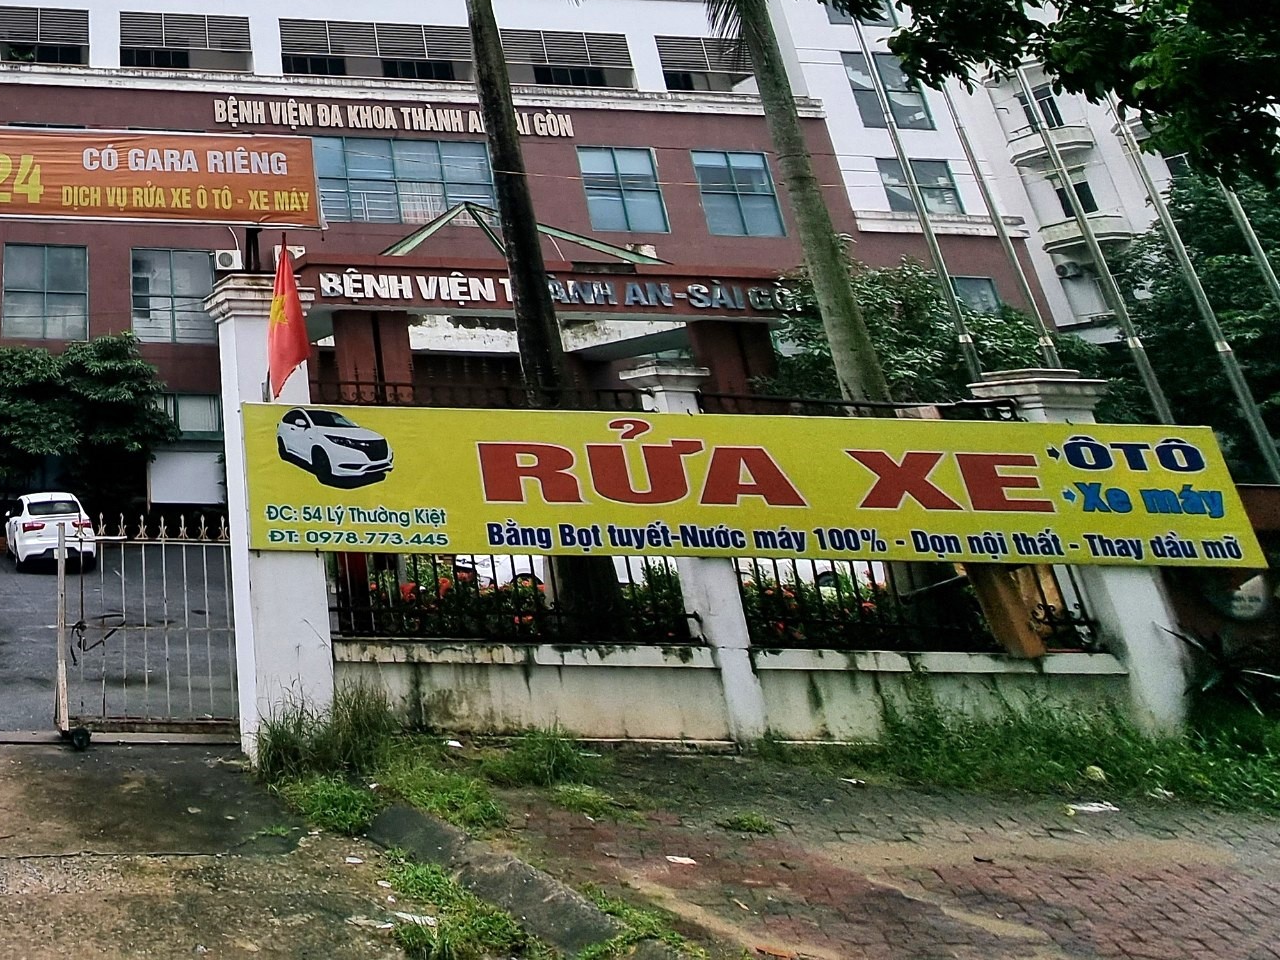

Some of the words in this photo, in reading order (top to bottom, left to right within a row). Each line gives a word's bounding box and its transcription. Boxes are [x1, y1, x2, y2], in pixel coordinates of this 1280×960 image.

[214, 96, 266, 128] BỆNH
[269, 99, 313, 130] VIỆN
[317, 104, 344, 128] ĐA
[347, 105, 397, 130] KHOA
[400, 104, 464, 132] THÀNH
[533, 109, 575, 137] GÒN
[82, 144, 120, 171] CÓ
[127, 148, 199, 173] GARA
[206, 147, 288, 176] RIÊNG
[61, 185, 102, 211] DỊCH
[105, 187, 128, 212] VỤ
[131, 181, 167, 209] RỬA
[170, 188, 192, 209] XE
[196, 185, 209, 210] Ô
[211, 185, 233, 210] TÔ
[247, 190, 270, 211] XE
[273, 188, 310, 212] MÁY
[319, 267, 413, 303] BỆNH
[416, 271, 497, 306] VIỆN
[498, 274, 619, 306] TÀNH
[623, 279, 746, 310] AN-SÀI
[746, 282, 800, 312] GÒ
[478, 419, 808, 506] RỬA
[845, 450, 1056, 513] XE
[1064, 436, 1206, 472] ÔTÔ
[266, 505, 298, 522] ĐC:
[302, 506, 322, 522] 54
[326, 505, 345, 526] Lý
[348, 506, 411, 527] Thường
[414, 508, 447, 528] Kiệt
[1074, 482, 1132, 514] Xe
[1140, 483, 1225, 519] máy
[268, 530, 299, 543] ĐT:
[306, 531, 449, 546] 0978.773.445
[486, 518, 552, 550] Bằng
[558, 523, 603, 552] Bọt
[607, 520, 746, 550] tuyết-Nước
[753, 526, 806, 552] máy
[812, 527, 888, 553] 100%
[910, 530, 963, 559] Dọn
[967, 531, 1009, 560] nội
[1012, 528, 1065, 556] thất
[1083, 534, 1142, 560] Thay
[1149, 530, 1198, 559] dầu
[1200, 535, 1243, 560] mỡ
